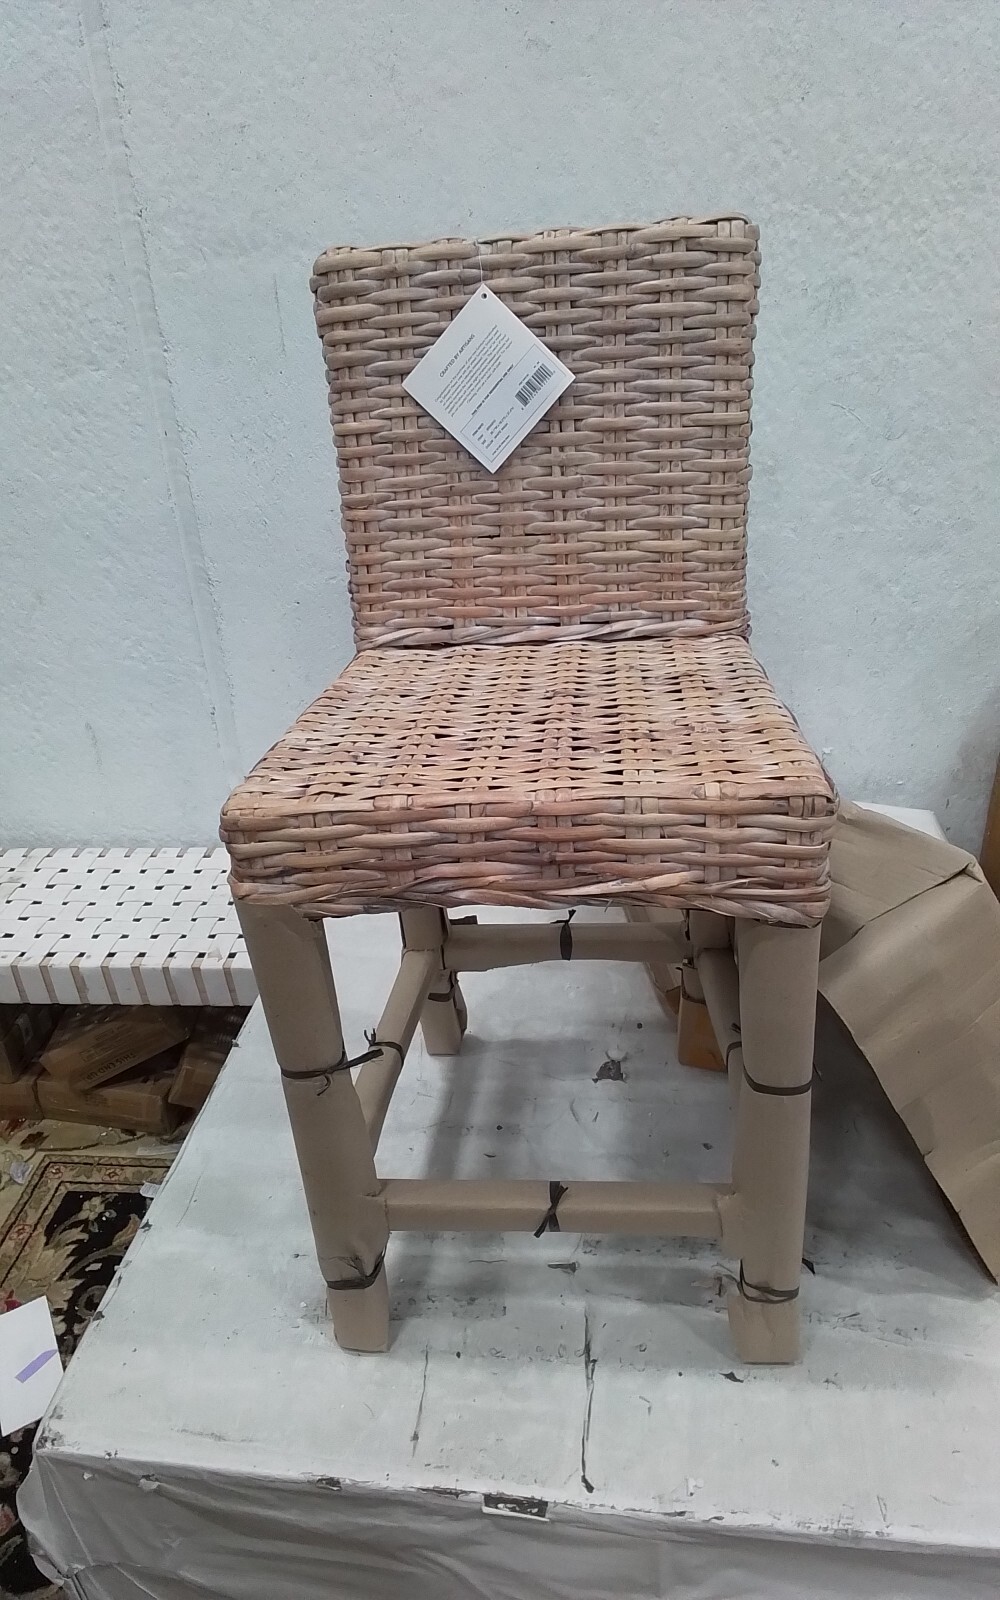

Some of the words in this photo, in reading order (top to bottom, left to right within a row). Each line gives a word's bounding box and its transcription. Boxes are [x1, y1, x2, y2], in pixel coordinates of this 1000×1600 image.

[438, 357, 456, 378] CRAFTED
[452, 351, 460, 360] BY
[456, 332, 476, 355] ARTISANS
